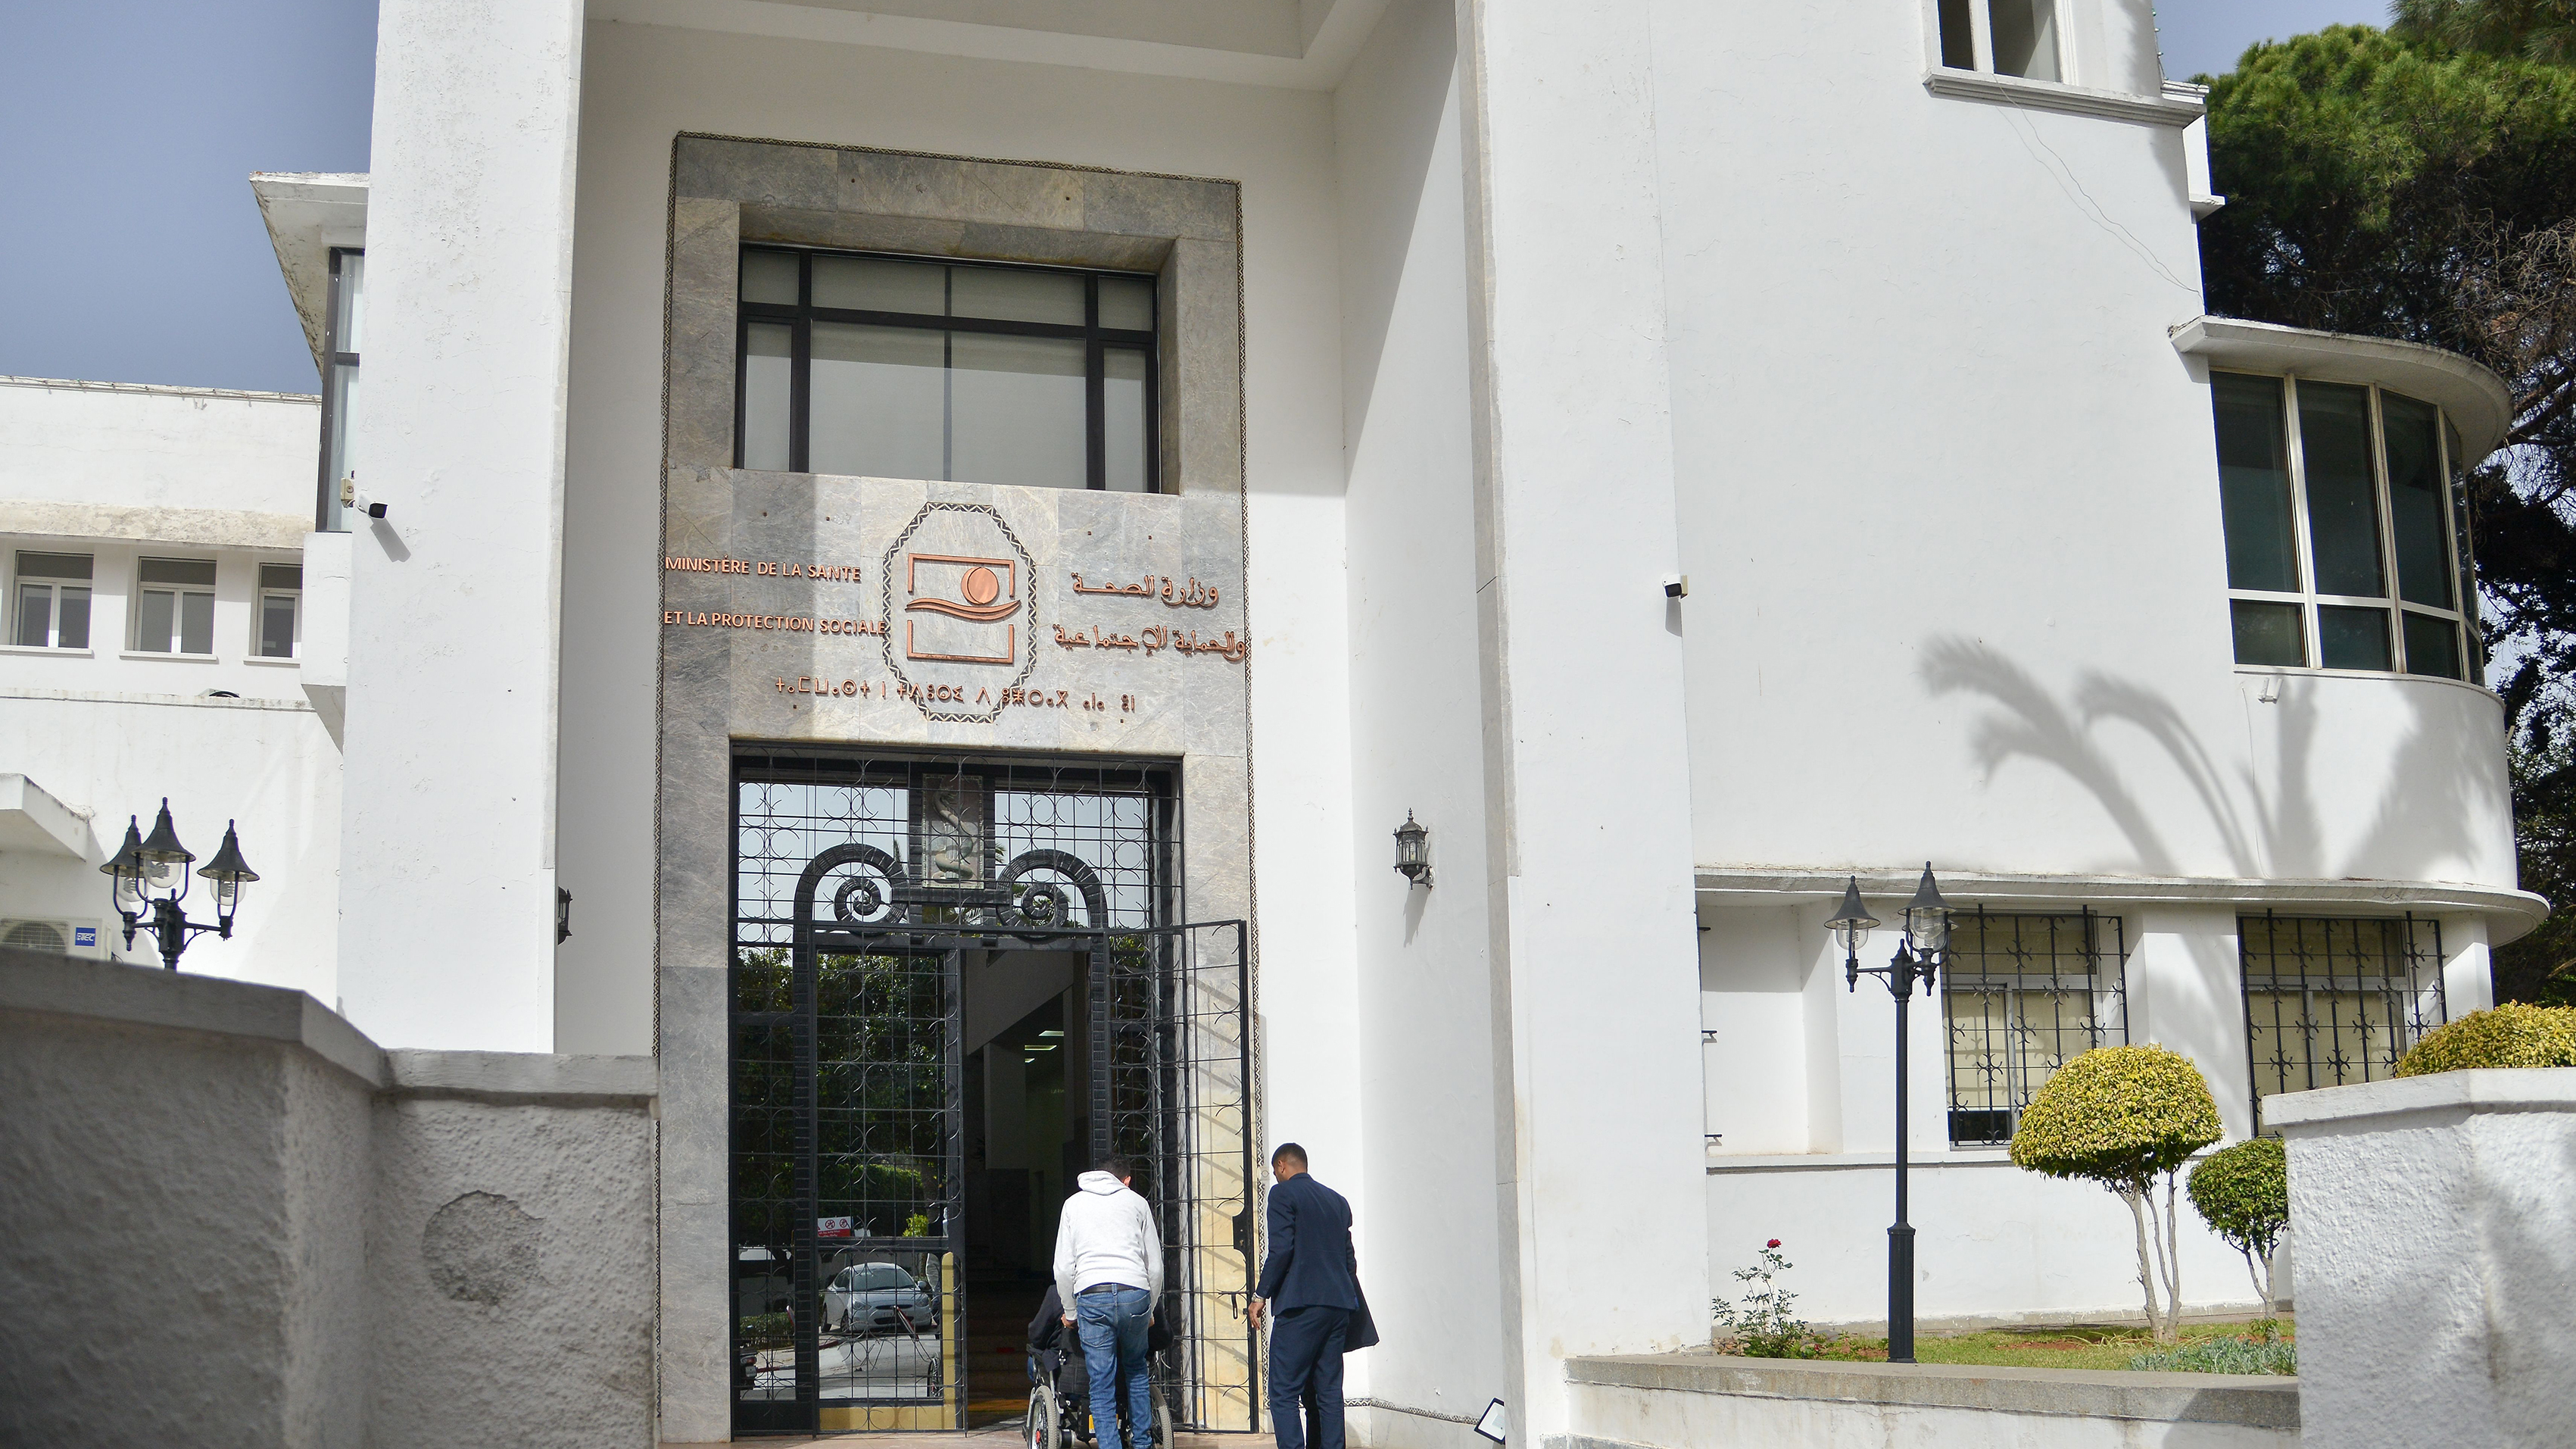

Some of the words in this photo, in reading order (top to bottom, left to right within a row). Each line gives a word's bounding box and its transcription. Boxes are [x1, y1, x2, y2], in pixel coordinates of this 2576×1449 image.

[757, 561, 777, 576] DE
[782, 563, 802, 577] LA
[807, 564, 862, 580] SANTE
[1071, 573, 1155, 596] الصحة
[1161, 577, 1219, 606] وزارة
[664, 611, 683, 624] ET
[688, 611, 708, 625] LA
[711, 613, 814, 631] PROTECTION
[819, 619, 886, 635] SOCIALE
